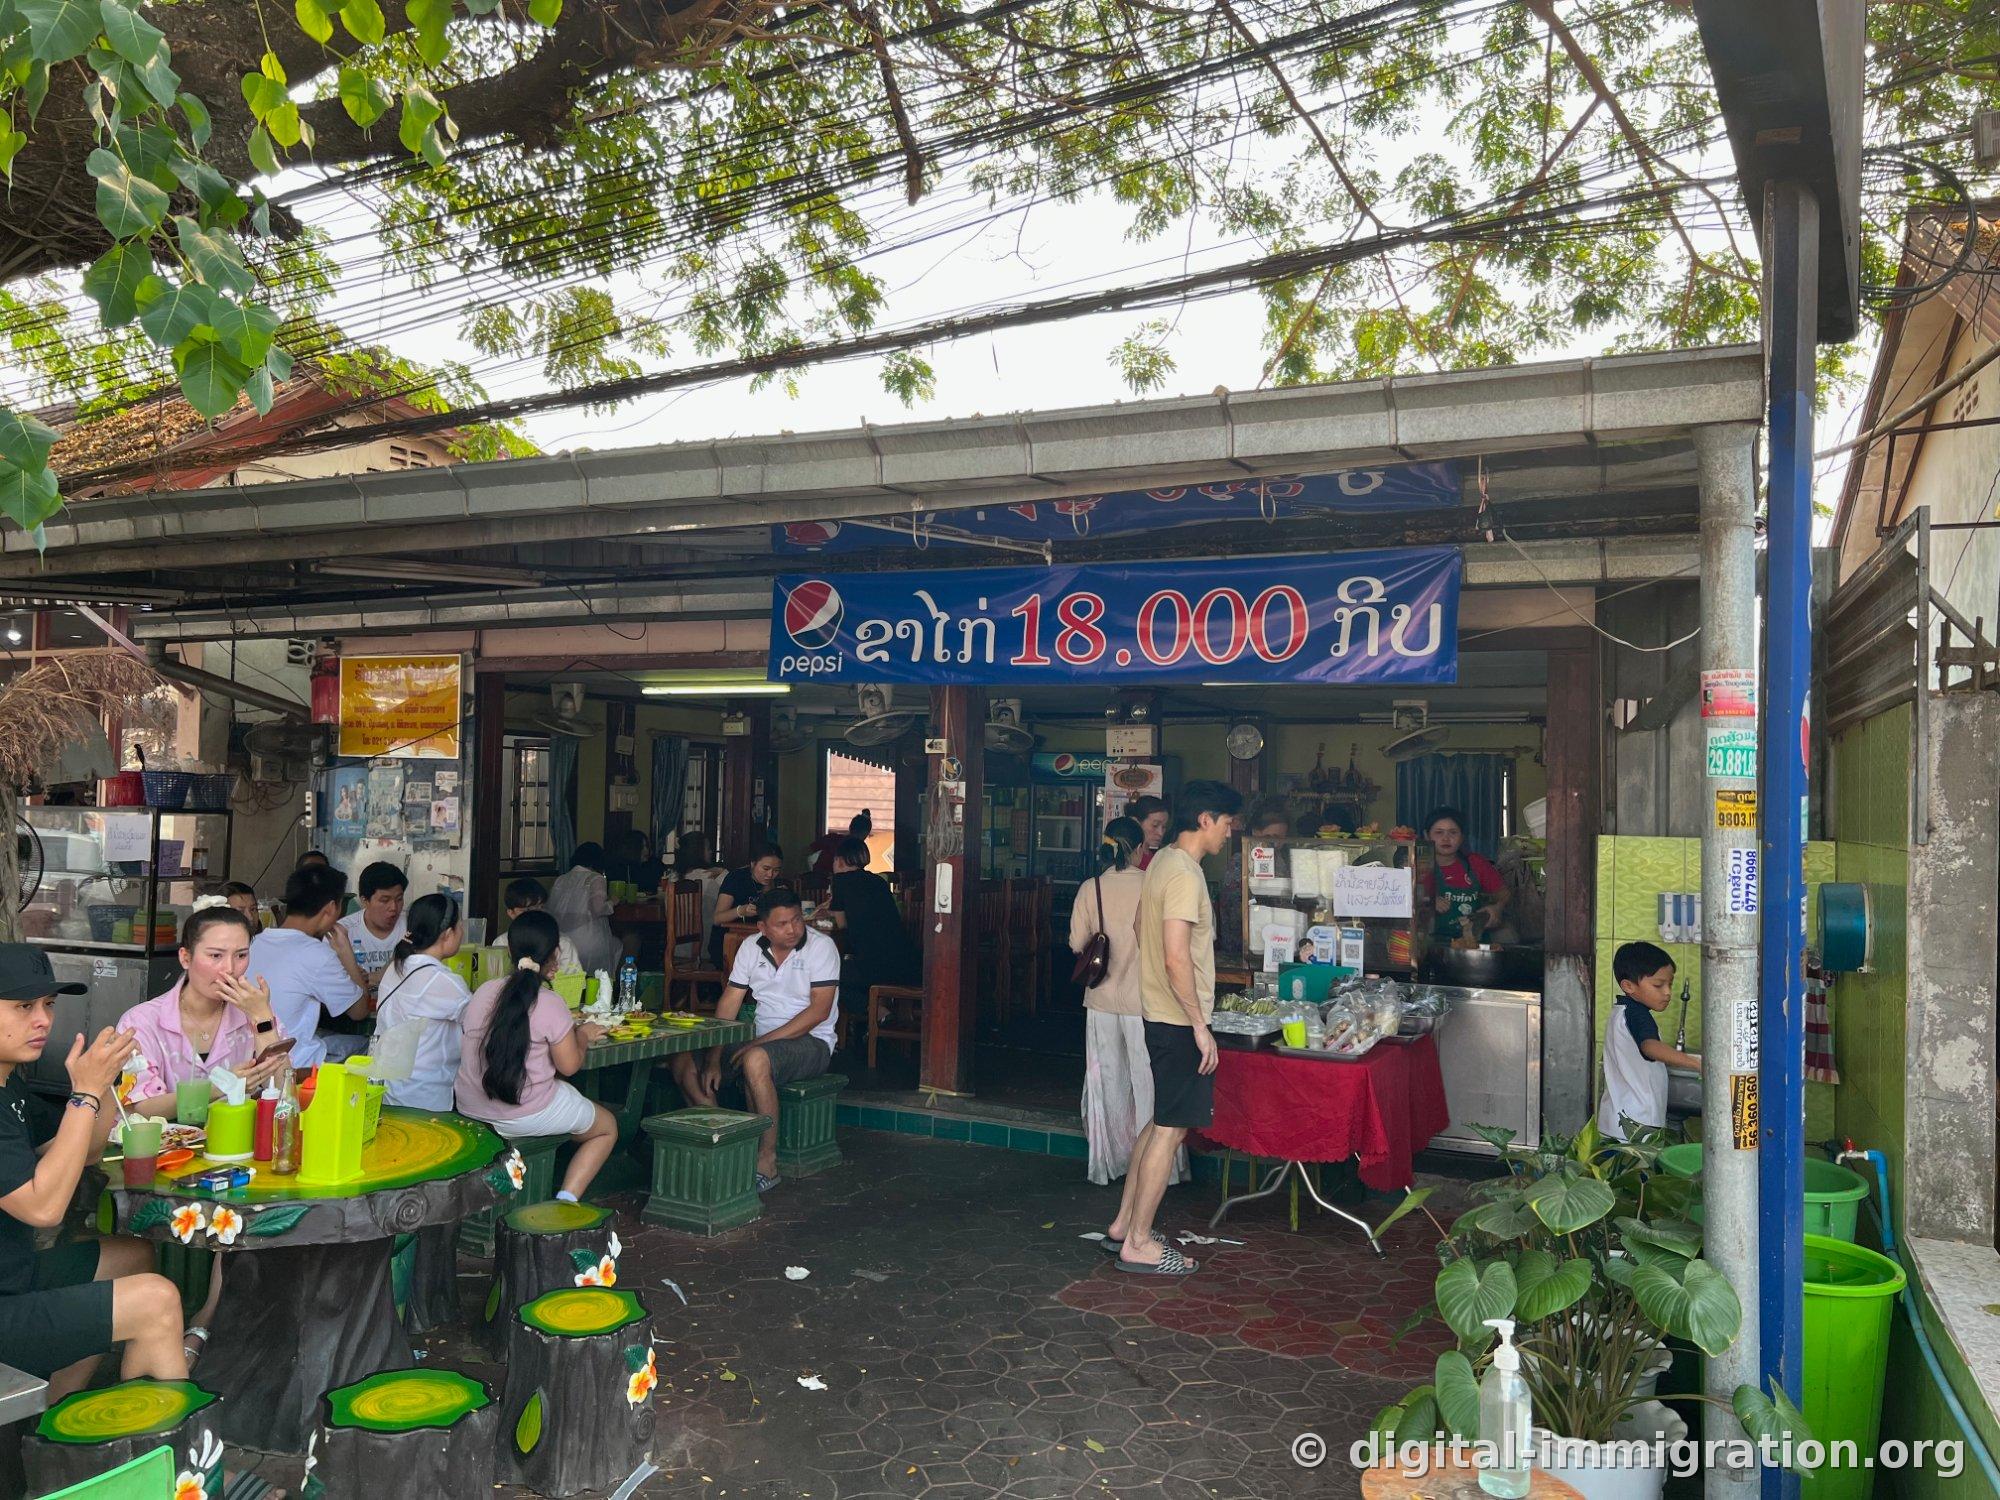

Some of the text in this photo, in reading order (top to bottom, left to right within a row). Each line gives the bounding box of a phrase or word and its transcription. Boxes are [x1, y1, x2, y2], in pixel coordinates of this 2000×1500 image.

[854, 575, 1443, 667] ຂາໄກ່ 18.000 ກີບ
[779, 650, 844, 678] pepsi
